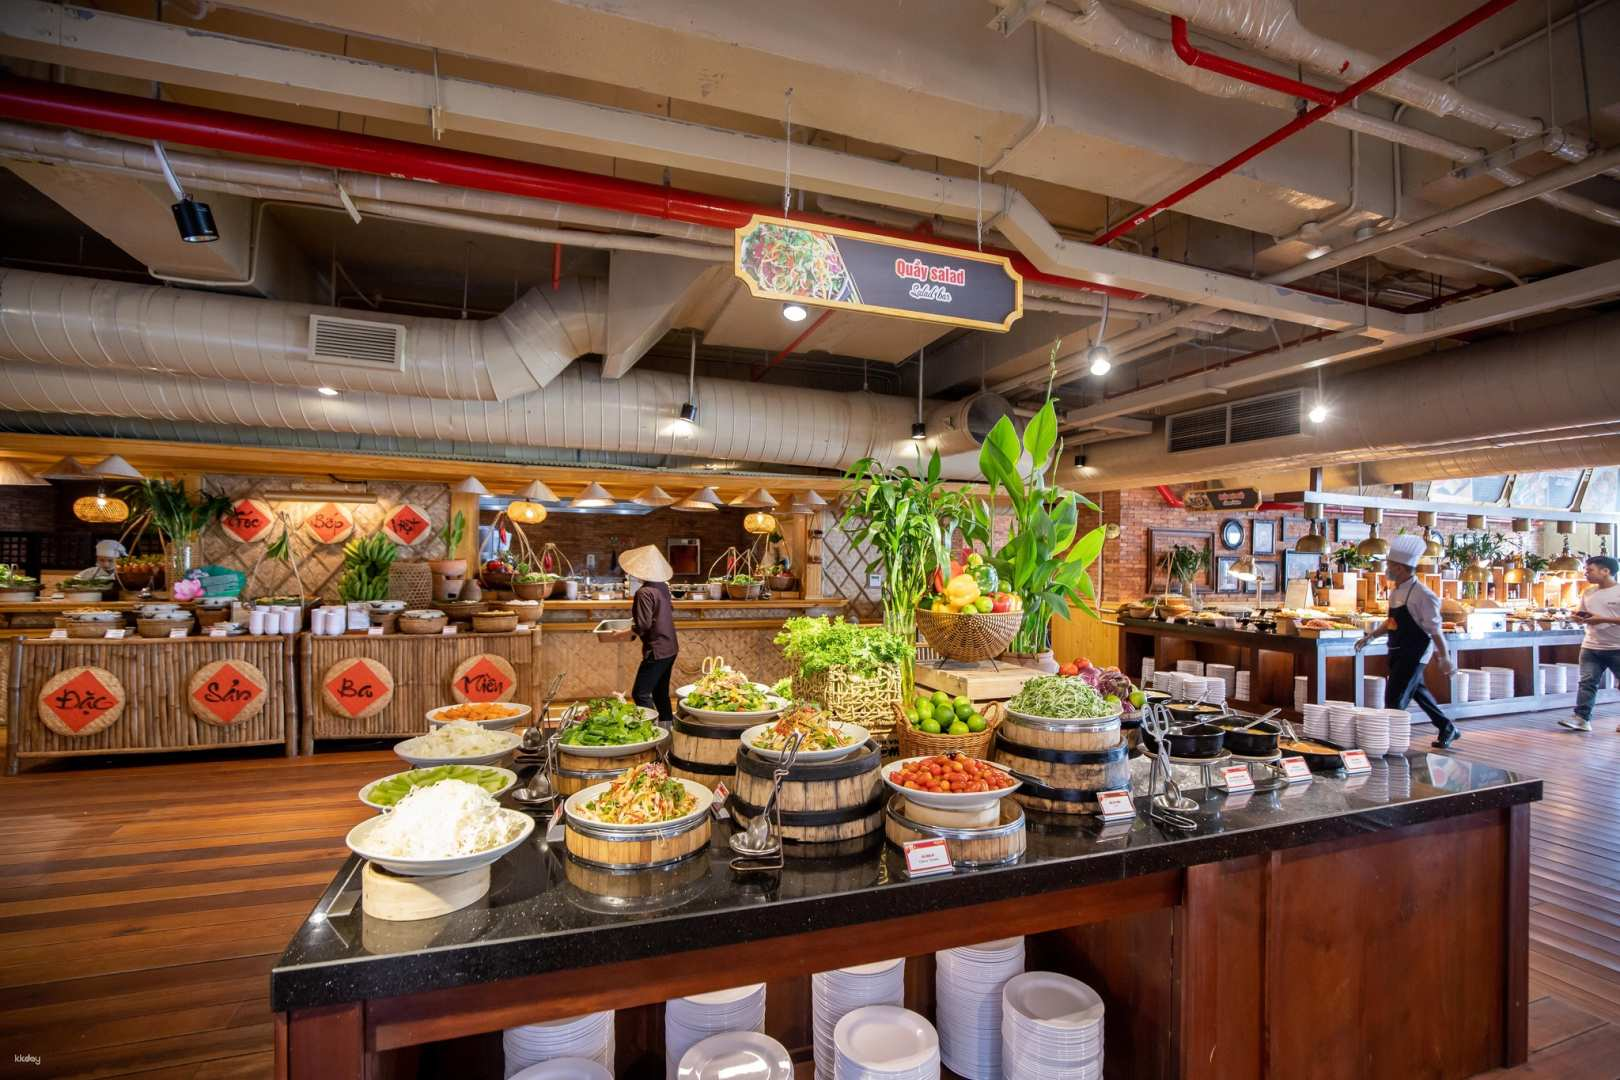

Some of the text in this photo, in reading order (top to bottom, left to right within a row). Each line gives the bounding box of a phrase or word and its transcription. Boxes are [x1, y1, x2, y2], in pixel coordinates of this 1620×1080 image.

[929, 266, 965, 286] salad
[55, 689, 115, 715] Đặc
[204, 679, 252, 702] Sản
[337, 678, 373, 697] Ba
